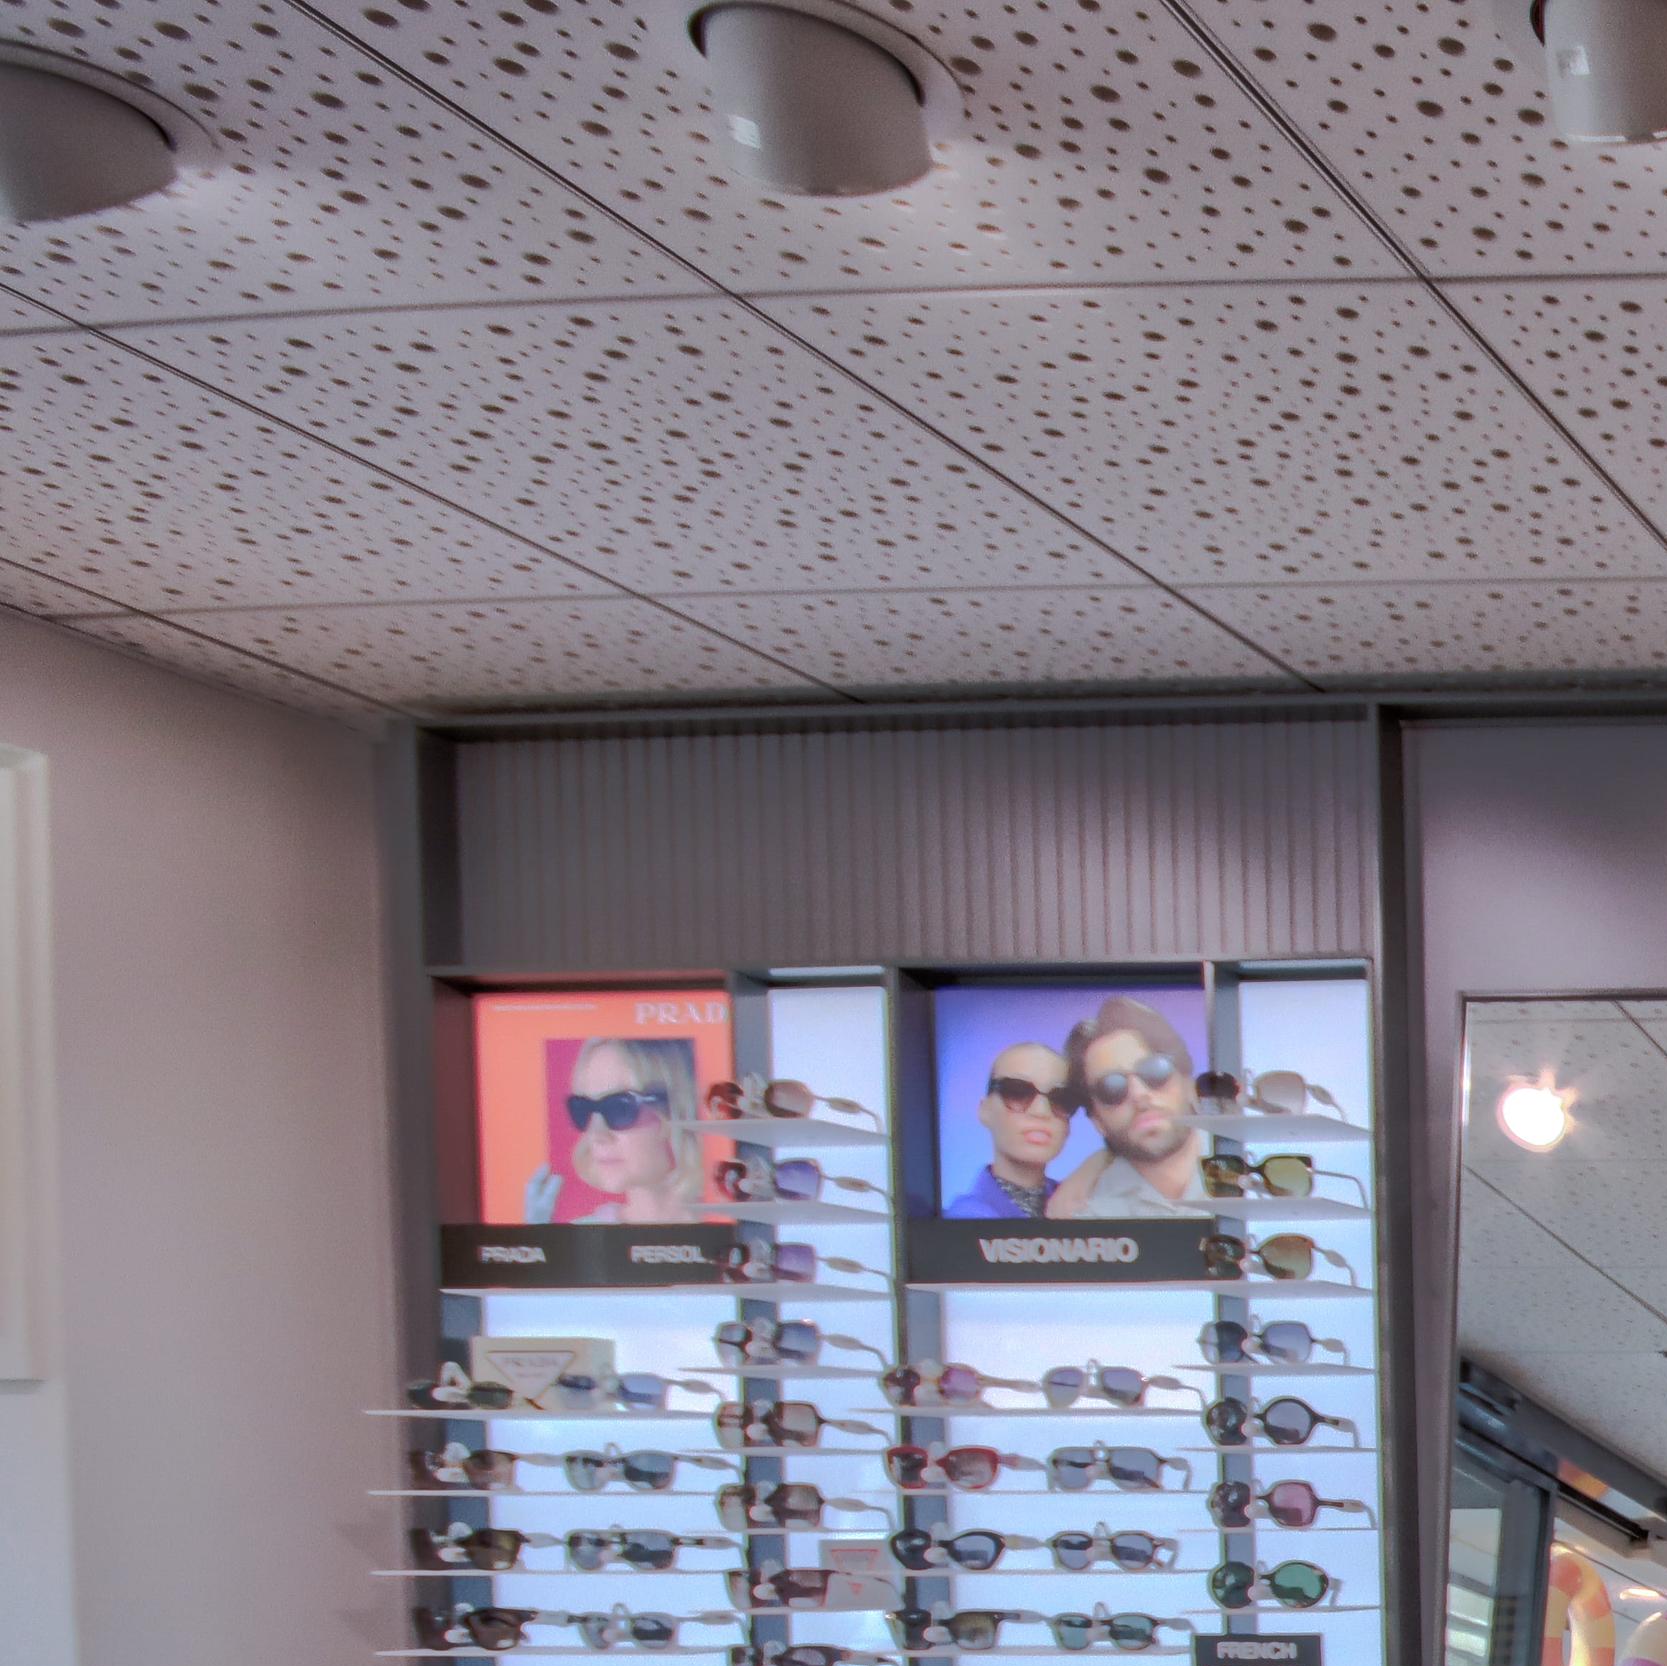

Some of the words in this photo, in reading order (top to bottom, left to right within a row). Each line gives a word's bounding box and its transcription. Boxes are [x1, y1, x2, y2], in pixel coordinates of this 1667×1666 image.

[634, 1001, 729, 1025] PRAD
[481, 1246, 547, 1264] PRADA
[630, 1245, 705, 1264] PERSOL
[978, 1237, 1140, 1263] VISIONARIO
[1217, 1641, 1297, 1659] FRENCH
